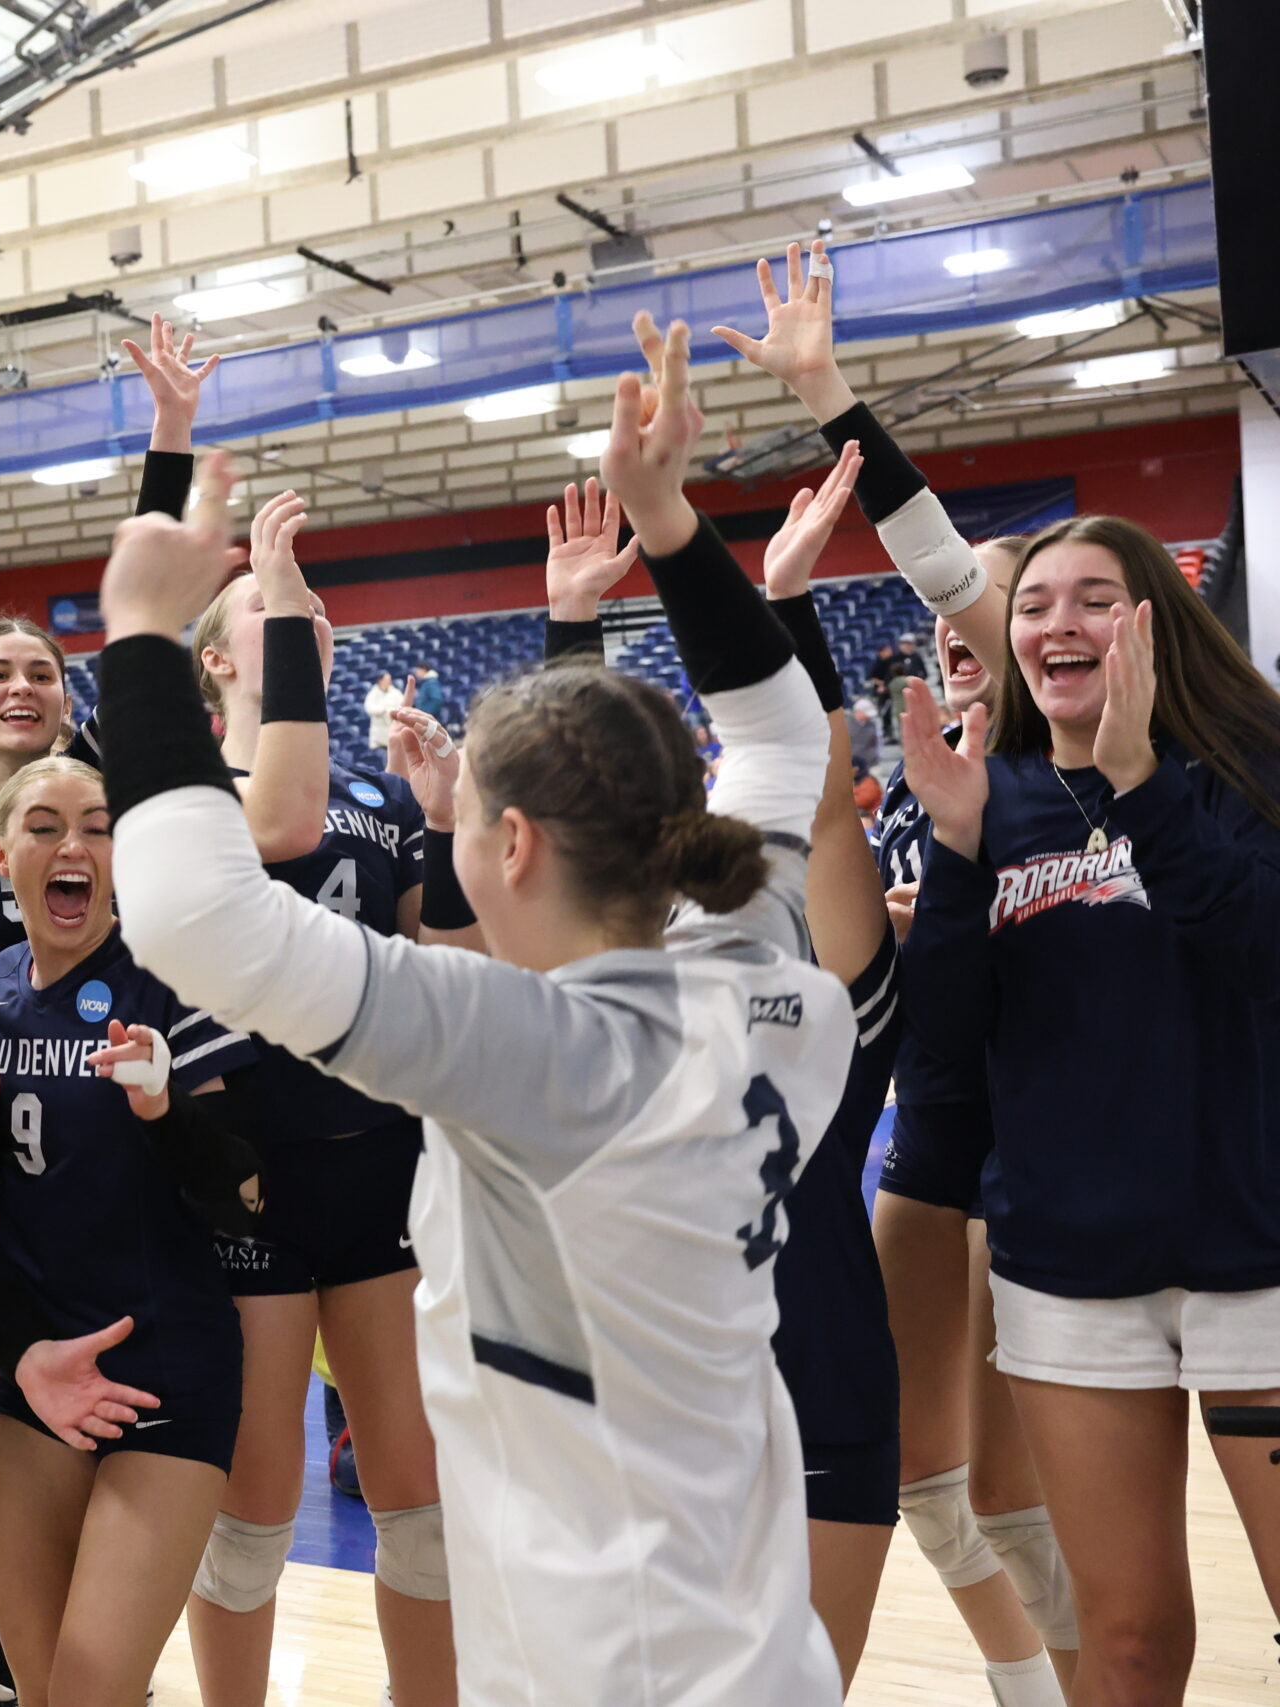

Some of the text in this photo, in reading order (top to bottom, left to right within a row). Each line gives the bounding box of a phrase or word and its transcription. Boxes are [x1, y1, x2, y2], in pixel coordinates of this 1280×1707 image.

[890, 839, 923, 887] 11
[988, 840, 1133, 931] ROADRUN
[316, 857, 361, 922] 4
[1017, 884, 1077, 922] VOLLEYBALL
[79, 998, 110, 1014] NCAA
[10, 1092, 47, 1176] 9
[221, 1260, 269, 1270] ENVER
